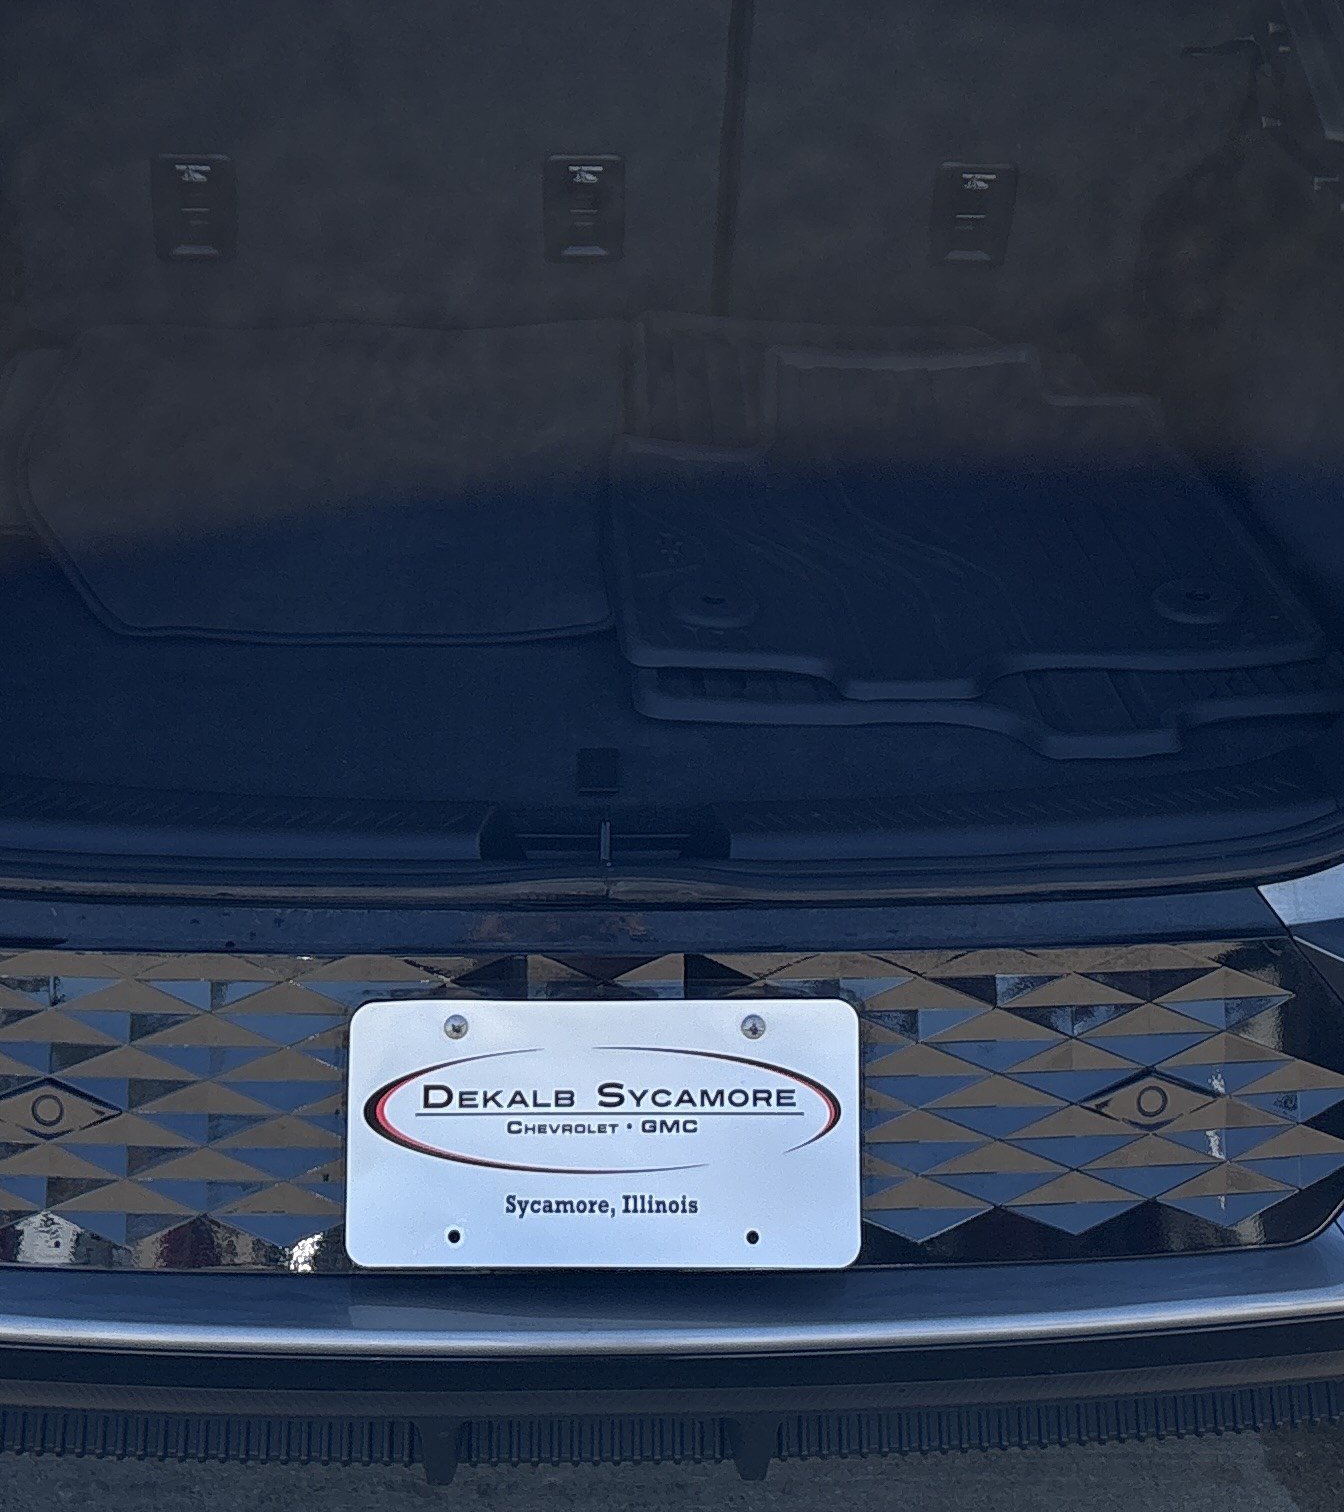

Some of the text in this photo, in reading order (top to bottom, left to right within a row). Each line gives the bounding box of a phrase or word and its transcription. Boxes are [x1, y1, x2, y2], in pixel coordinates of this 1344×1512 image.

[422, 1082, 797, 1109] DEKALB SYCAMORE
[506, 1119, 698, 1135] CHEVROLET GMC
[505, 1194, 699, 1218] Sycamore, Illinois
